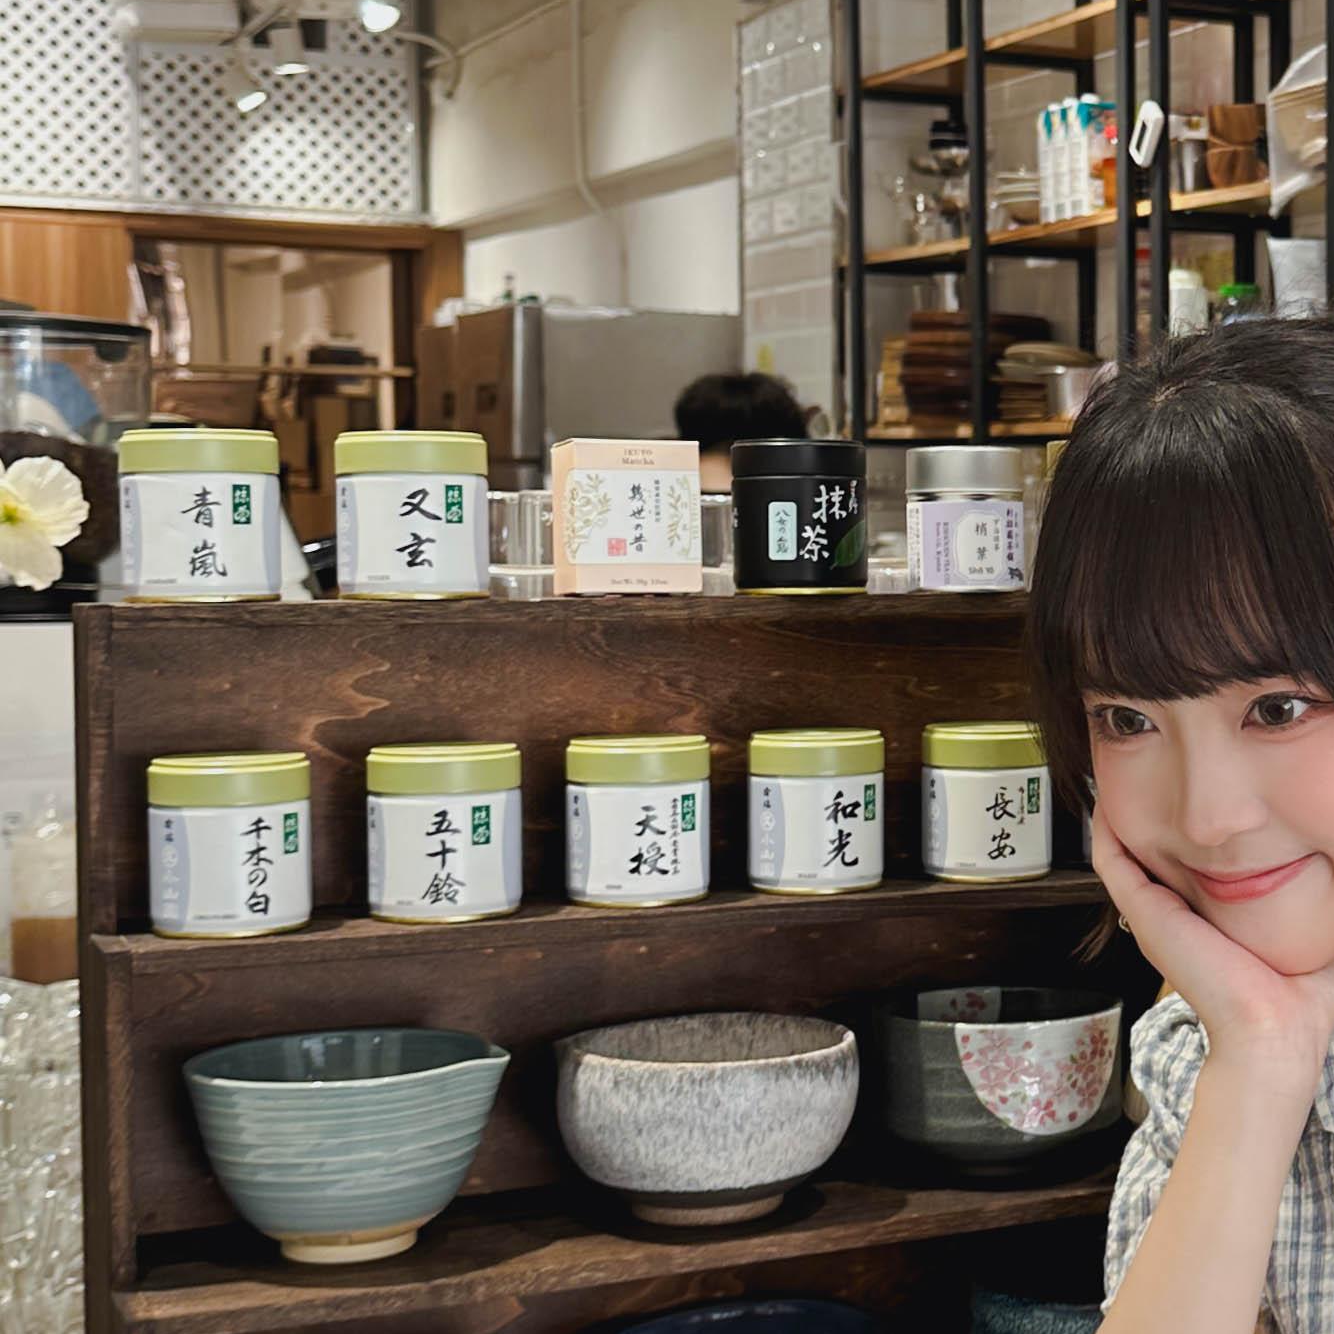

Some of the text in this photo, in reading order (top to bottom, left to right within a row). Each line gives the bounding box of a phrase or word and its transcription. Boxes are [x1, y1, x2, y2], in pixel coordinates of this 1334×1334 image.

[799, 484, 848, 563] 抹茶
[421, 809, 466, 905] 五十鈴
[628, 805, 670, 876] 天授
[823, 790, 861, 867] 和光
